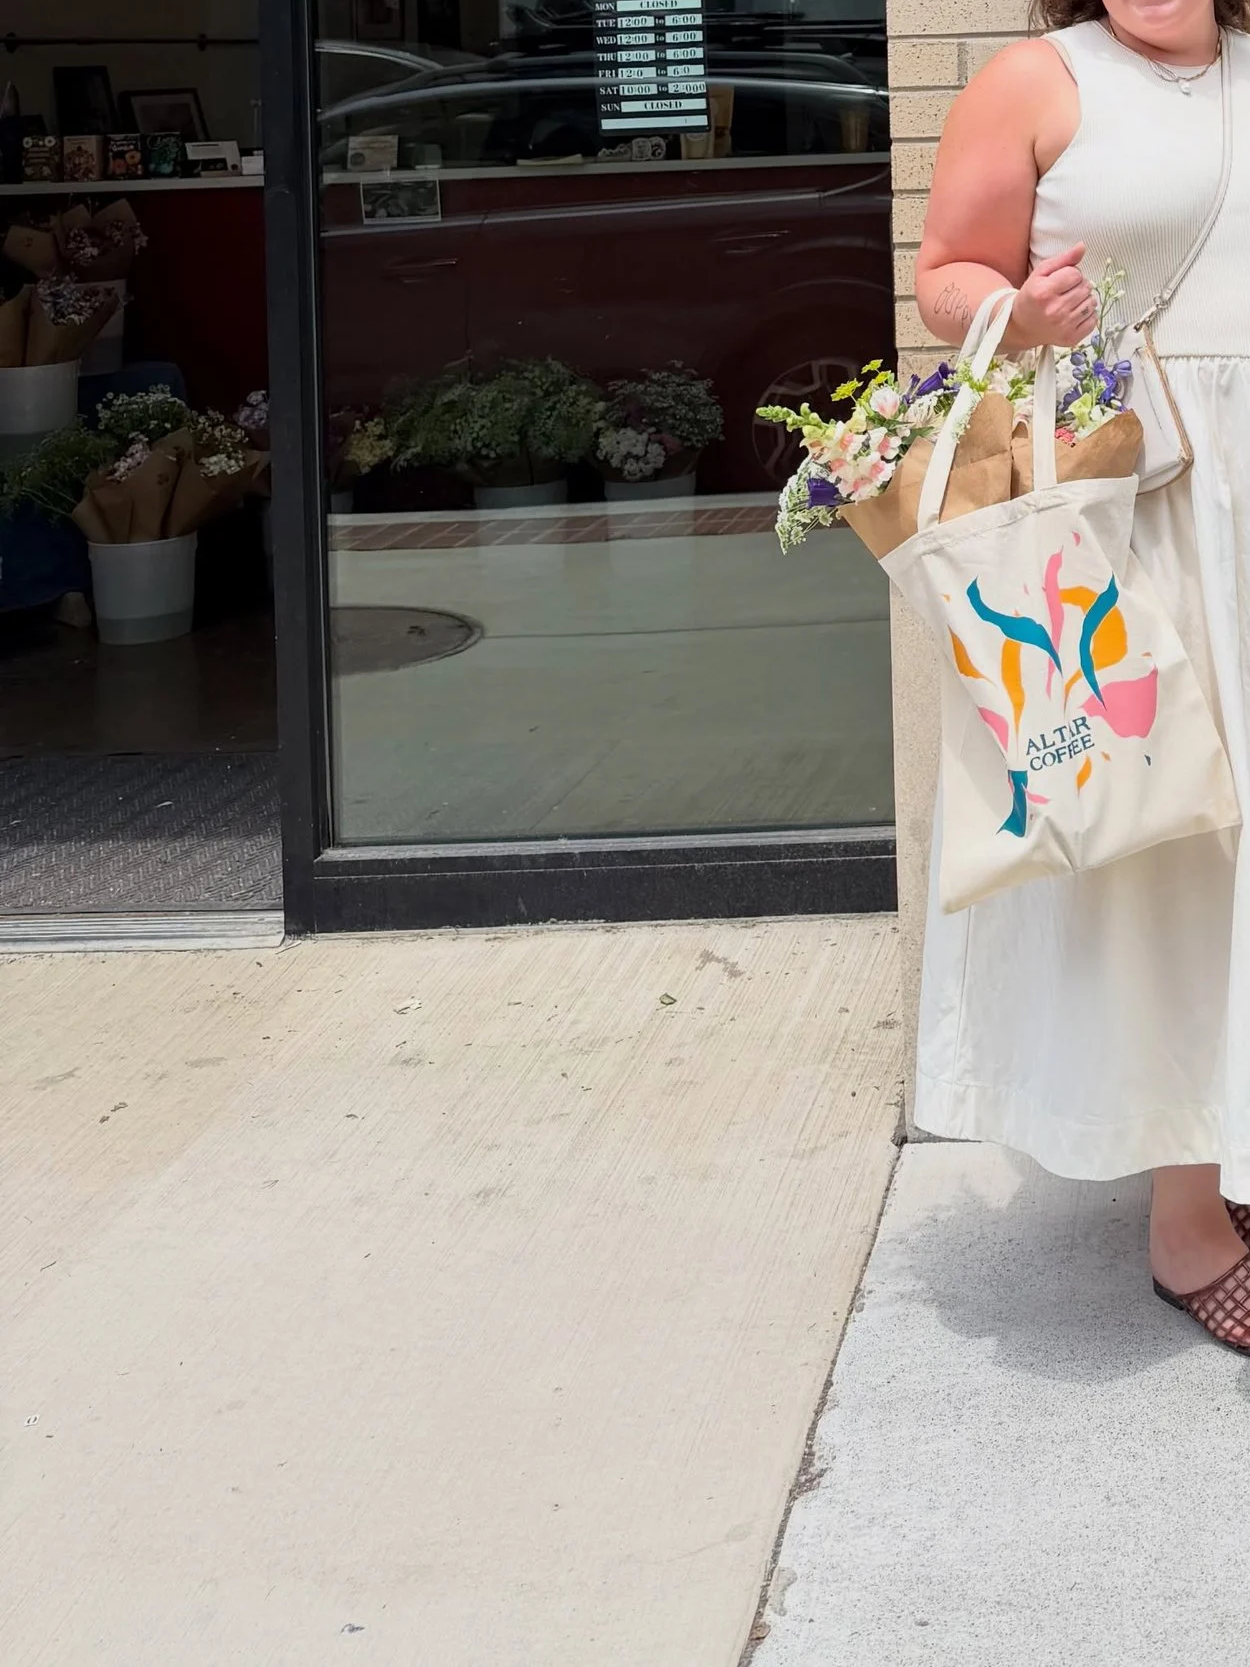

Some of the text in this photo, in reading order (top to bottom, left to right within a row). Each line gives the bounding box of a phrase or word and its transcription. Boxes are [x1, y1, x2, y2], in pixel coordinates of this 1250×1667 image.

[595, 0, 678, 11] MON CLOSED
[596, 19, 616, 28] TUE
[620, 17, 647, 28] 12:00
[672, 15, 696, 25] 6:00
[596, 36, 616, 45] WED
[620, 34, 648, 44] 12:00
[672, 32, 697, 42] 6:00
[597, 53, 616, 62] THU
[673, 49, 697, 59] 6:00
[599, 70, 616, 78] FRI
[600, 86, 618, 95] SAT
[621, 85, 650, 95] 10:00
[601, 101, 682, 112] SUN CLOSED
